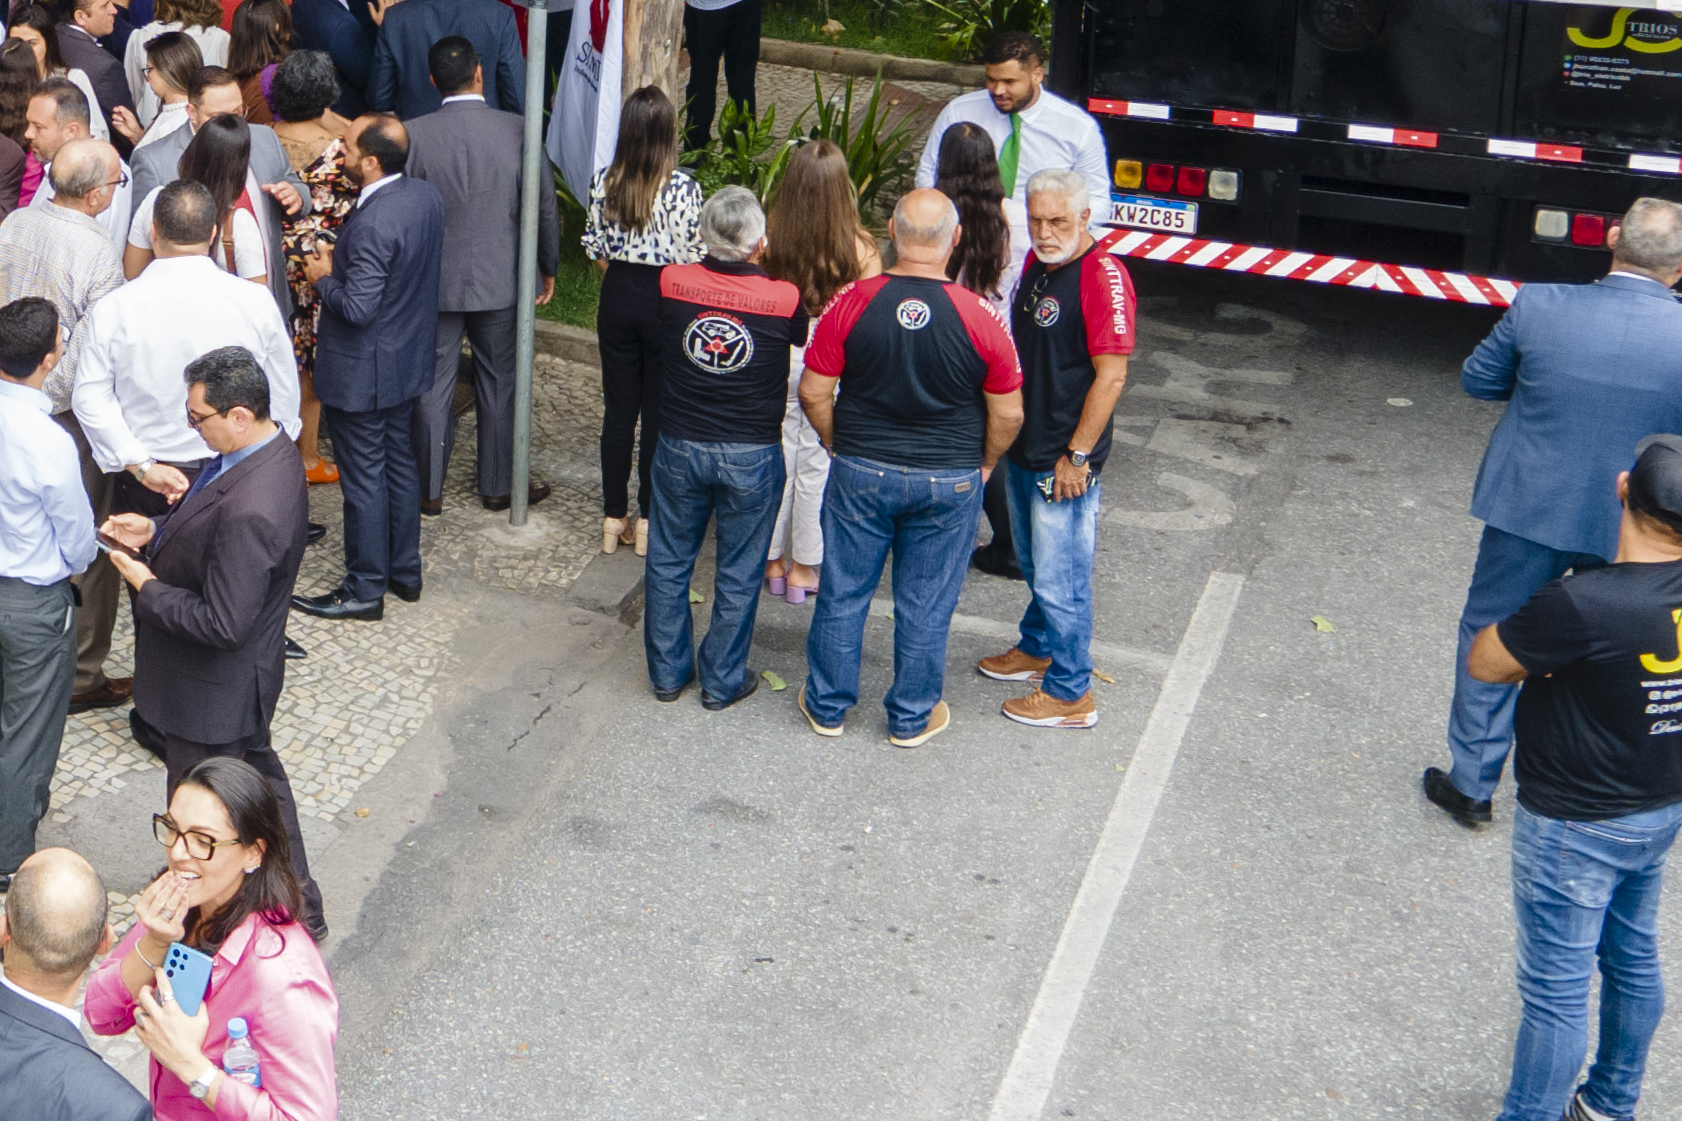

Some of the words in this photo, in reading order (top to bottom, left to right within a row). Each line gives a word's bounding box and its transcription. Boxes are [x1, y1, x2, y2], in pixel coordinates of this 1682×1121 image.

[1626, 21, 1678, 35] TRIOS
[1109, 204, 1185, 229] KW2C85
[671, 282, 722, 305] TRANSPORTE
[738, 296, 777, 313] VALORES
